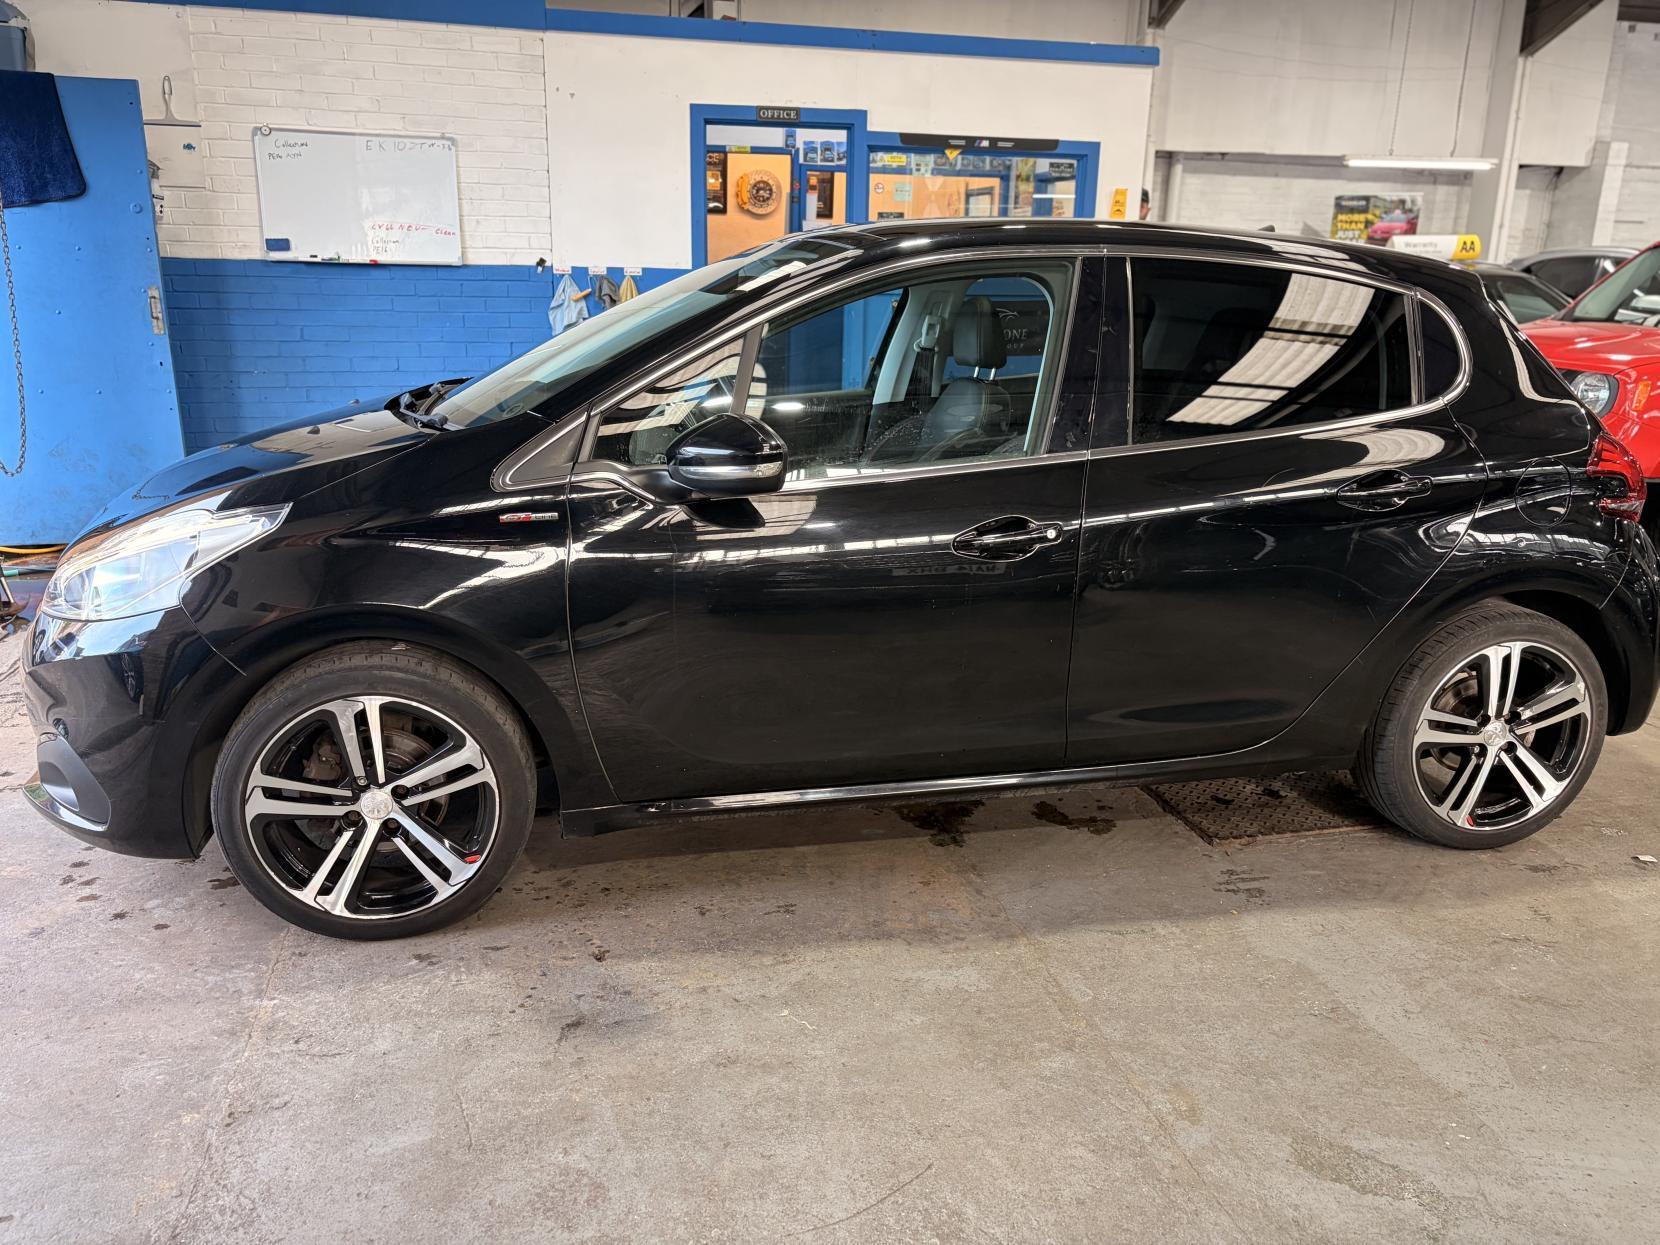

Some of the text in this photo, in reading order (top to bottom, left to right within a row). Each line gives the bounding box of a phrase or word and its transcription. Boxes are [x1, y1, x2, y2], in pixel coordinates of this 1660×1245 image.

[759, 109, 797, 119] OFFICE
[1337, 213, 1366, 222] MORE
[1337, 222, 1365, 230] THAN
[1335, 230, 1361, 239] JUST
[1459, 240, 1476, 253] AA
